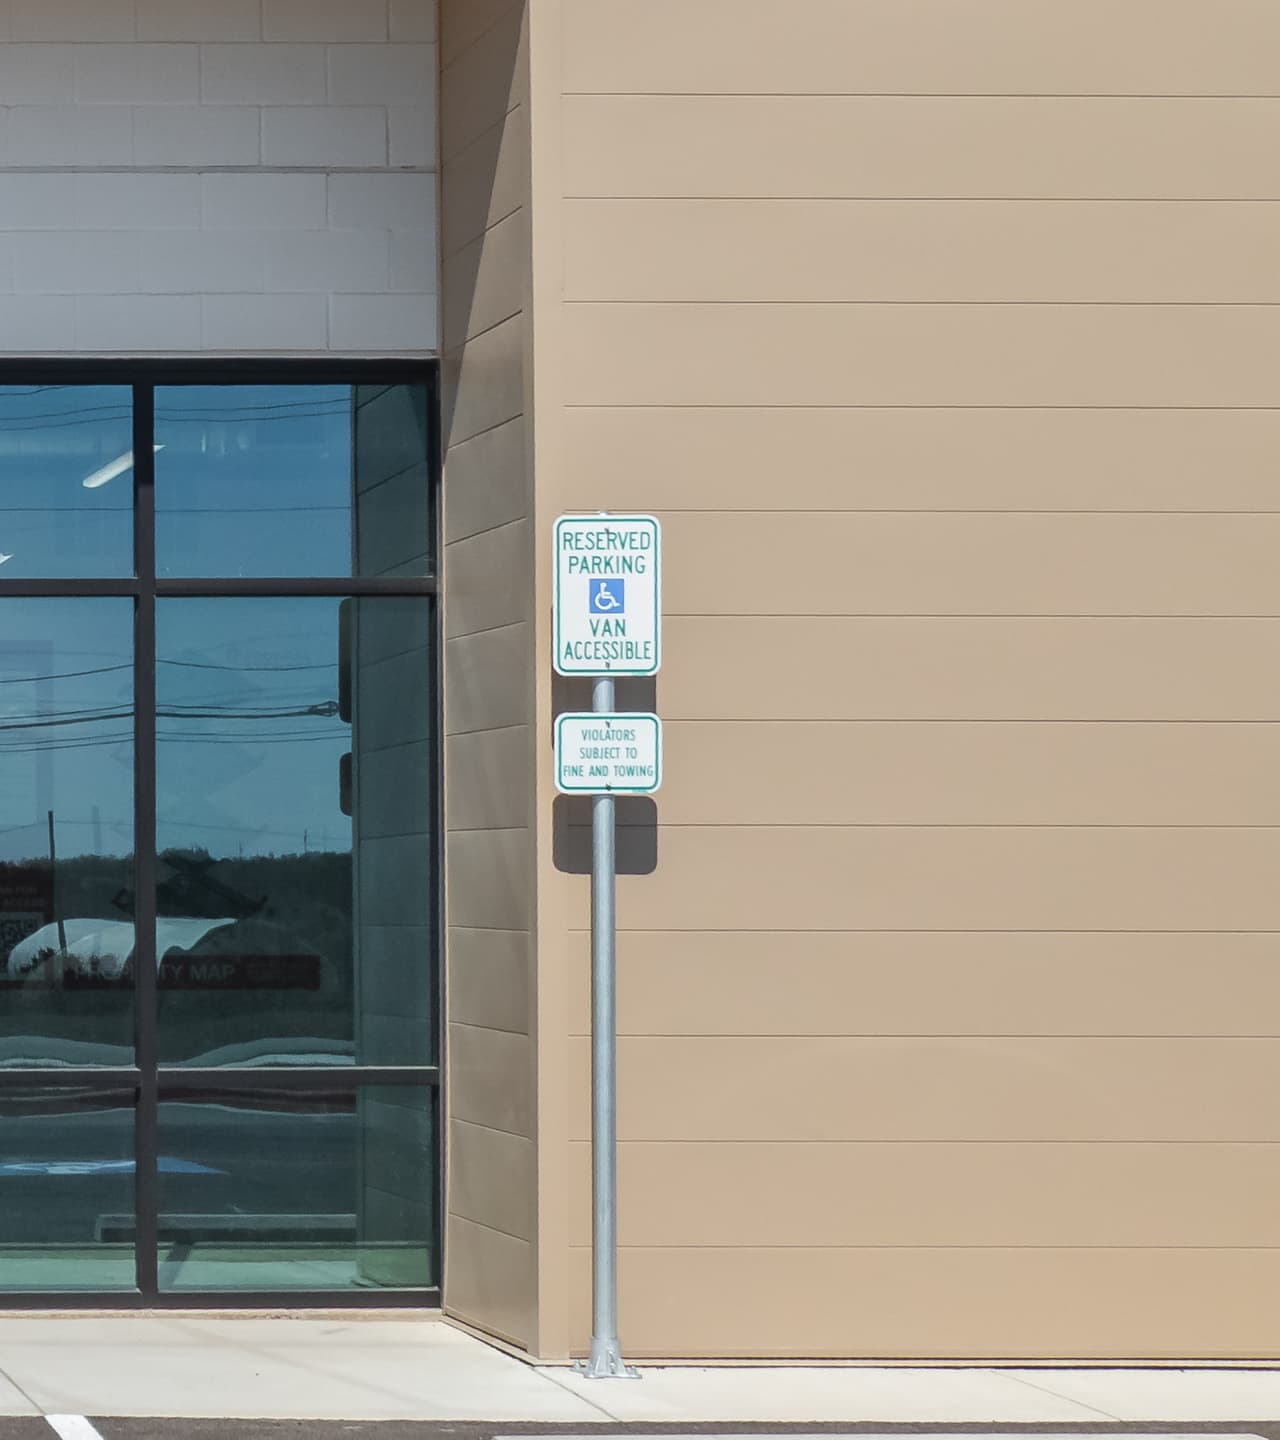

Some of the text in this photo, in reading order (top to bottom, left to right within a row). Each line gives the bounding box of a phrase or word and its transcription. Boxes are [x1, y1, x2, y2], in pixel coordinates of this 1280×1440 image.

[562, 531, 651, 551] RESERVED
[568, 555, 646, 574] PARKING
[588, 618, 627, 637] VAN
[563, 641, 652, 660] ACCESSIBLE
[581, 729, 636, 741] VIOLATORS
[579, 747, 638, 759] SUBJECT TO
[563, 765, 654, 777] FINE AND TOWING
